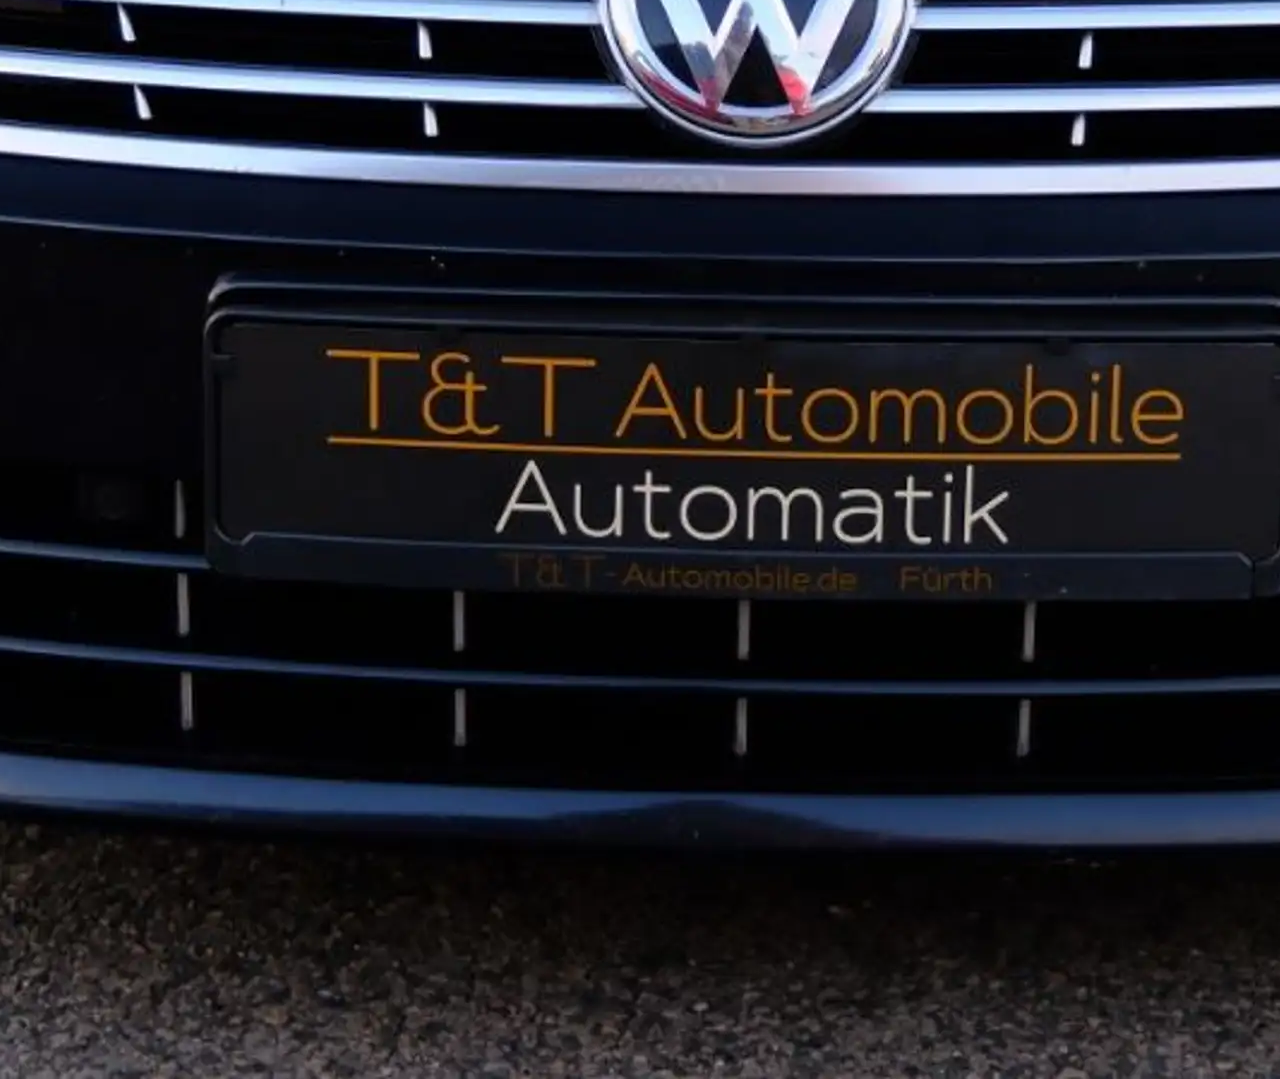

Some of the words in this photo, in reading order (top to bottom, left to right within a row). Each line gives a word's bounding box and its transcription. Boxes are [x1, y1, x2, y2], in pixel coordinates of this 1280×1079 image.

[326, 348, 597, 438] T&T
[615, 362, 1185, 447] Automobile
[494, 460, 1010, 546] Automatik
[899, 564, 995, 594] Fürth
